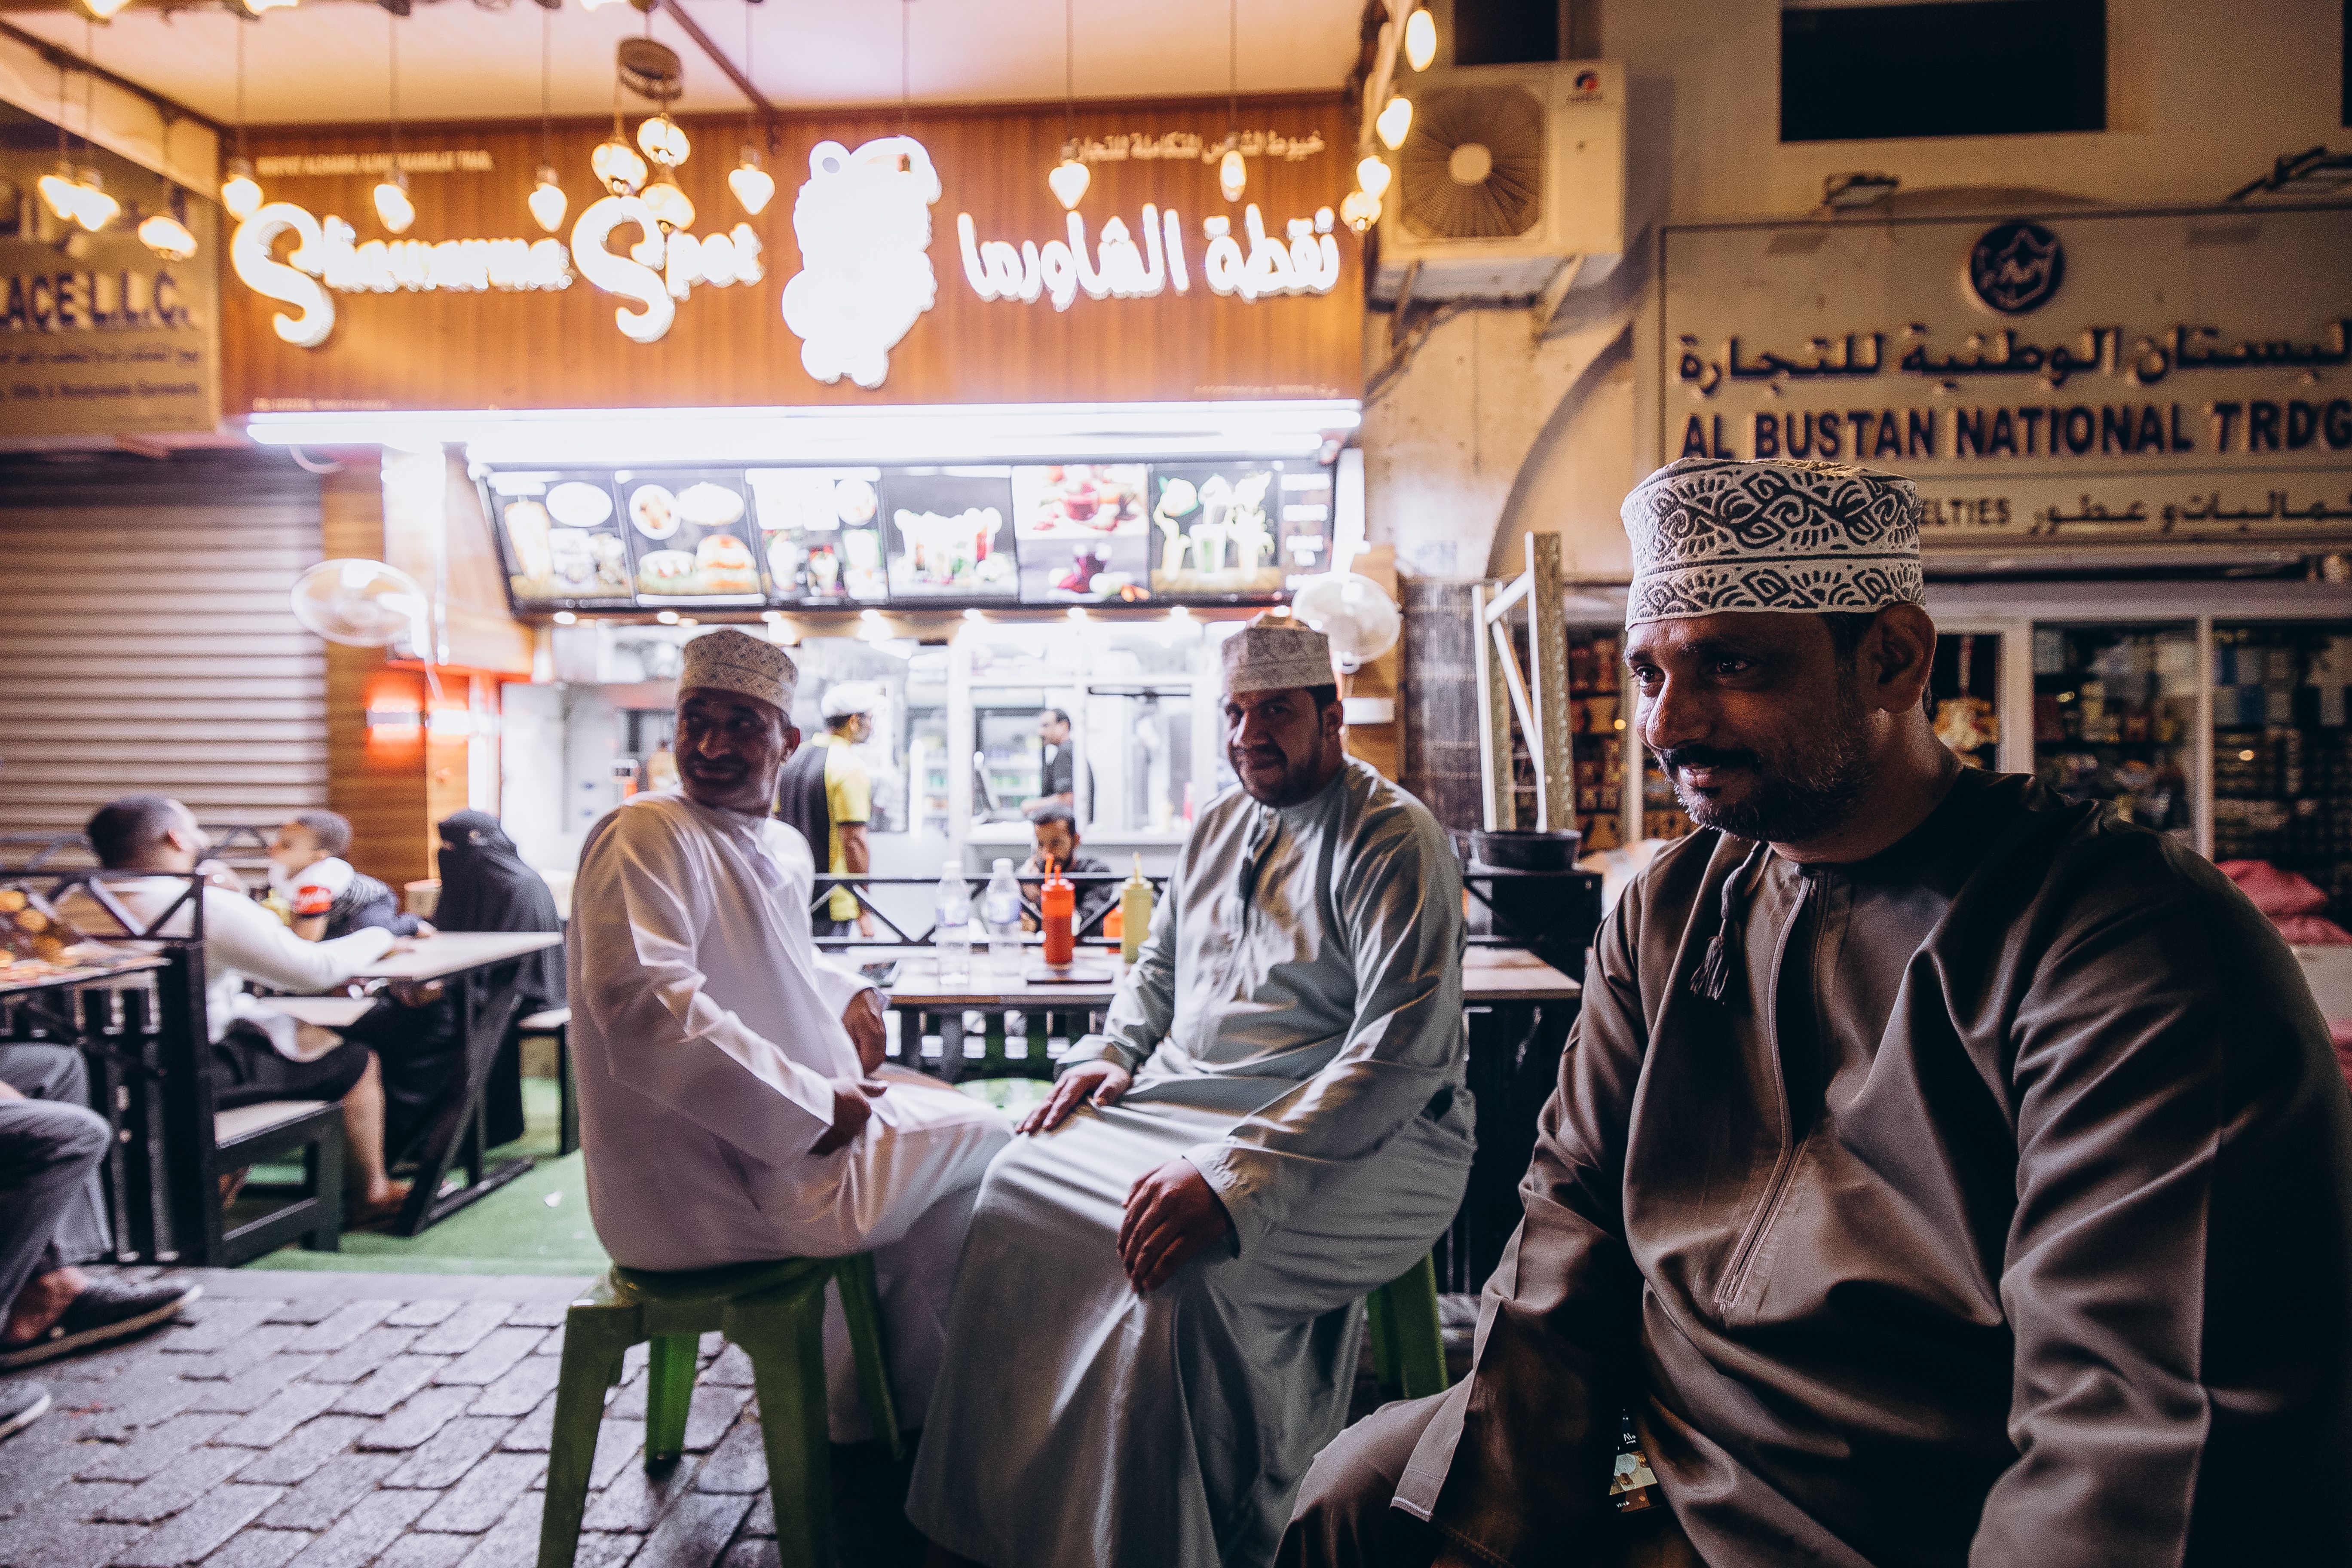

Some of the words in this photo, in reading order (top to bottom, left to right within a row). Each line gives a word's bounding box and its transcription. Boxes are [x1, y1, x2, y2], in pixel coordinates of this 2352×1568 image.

[956, 202, 1191, 312] الشاورما
[1203, 202, 1341, 304] نقطة
[0, 271, 75, 329] ACE
[1680, 332, 1885, 398] للتجارة
[1901, 322, 2122, 390] الوطنية
[1681, 412, 1733, 459] AL
[1755, 409, 1934, 458] BUSTAN
[1956, 403, 2194, 456] NATIONAL
